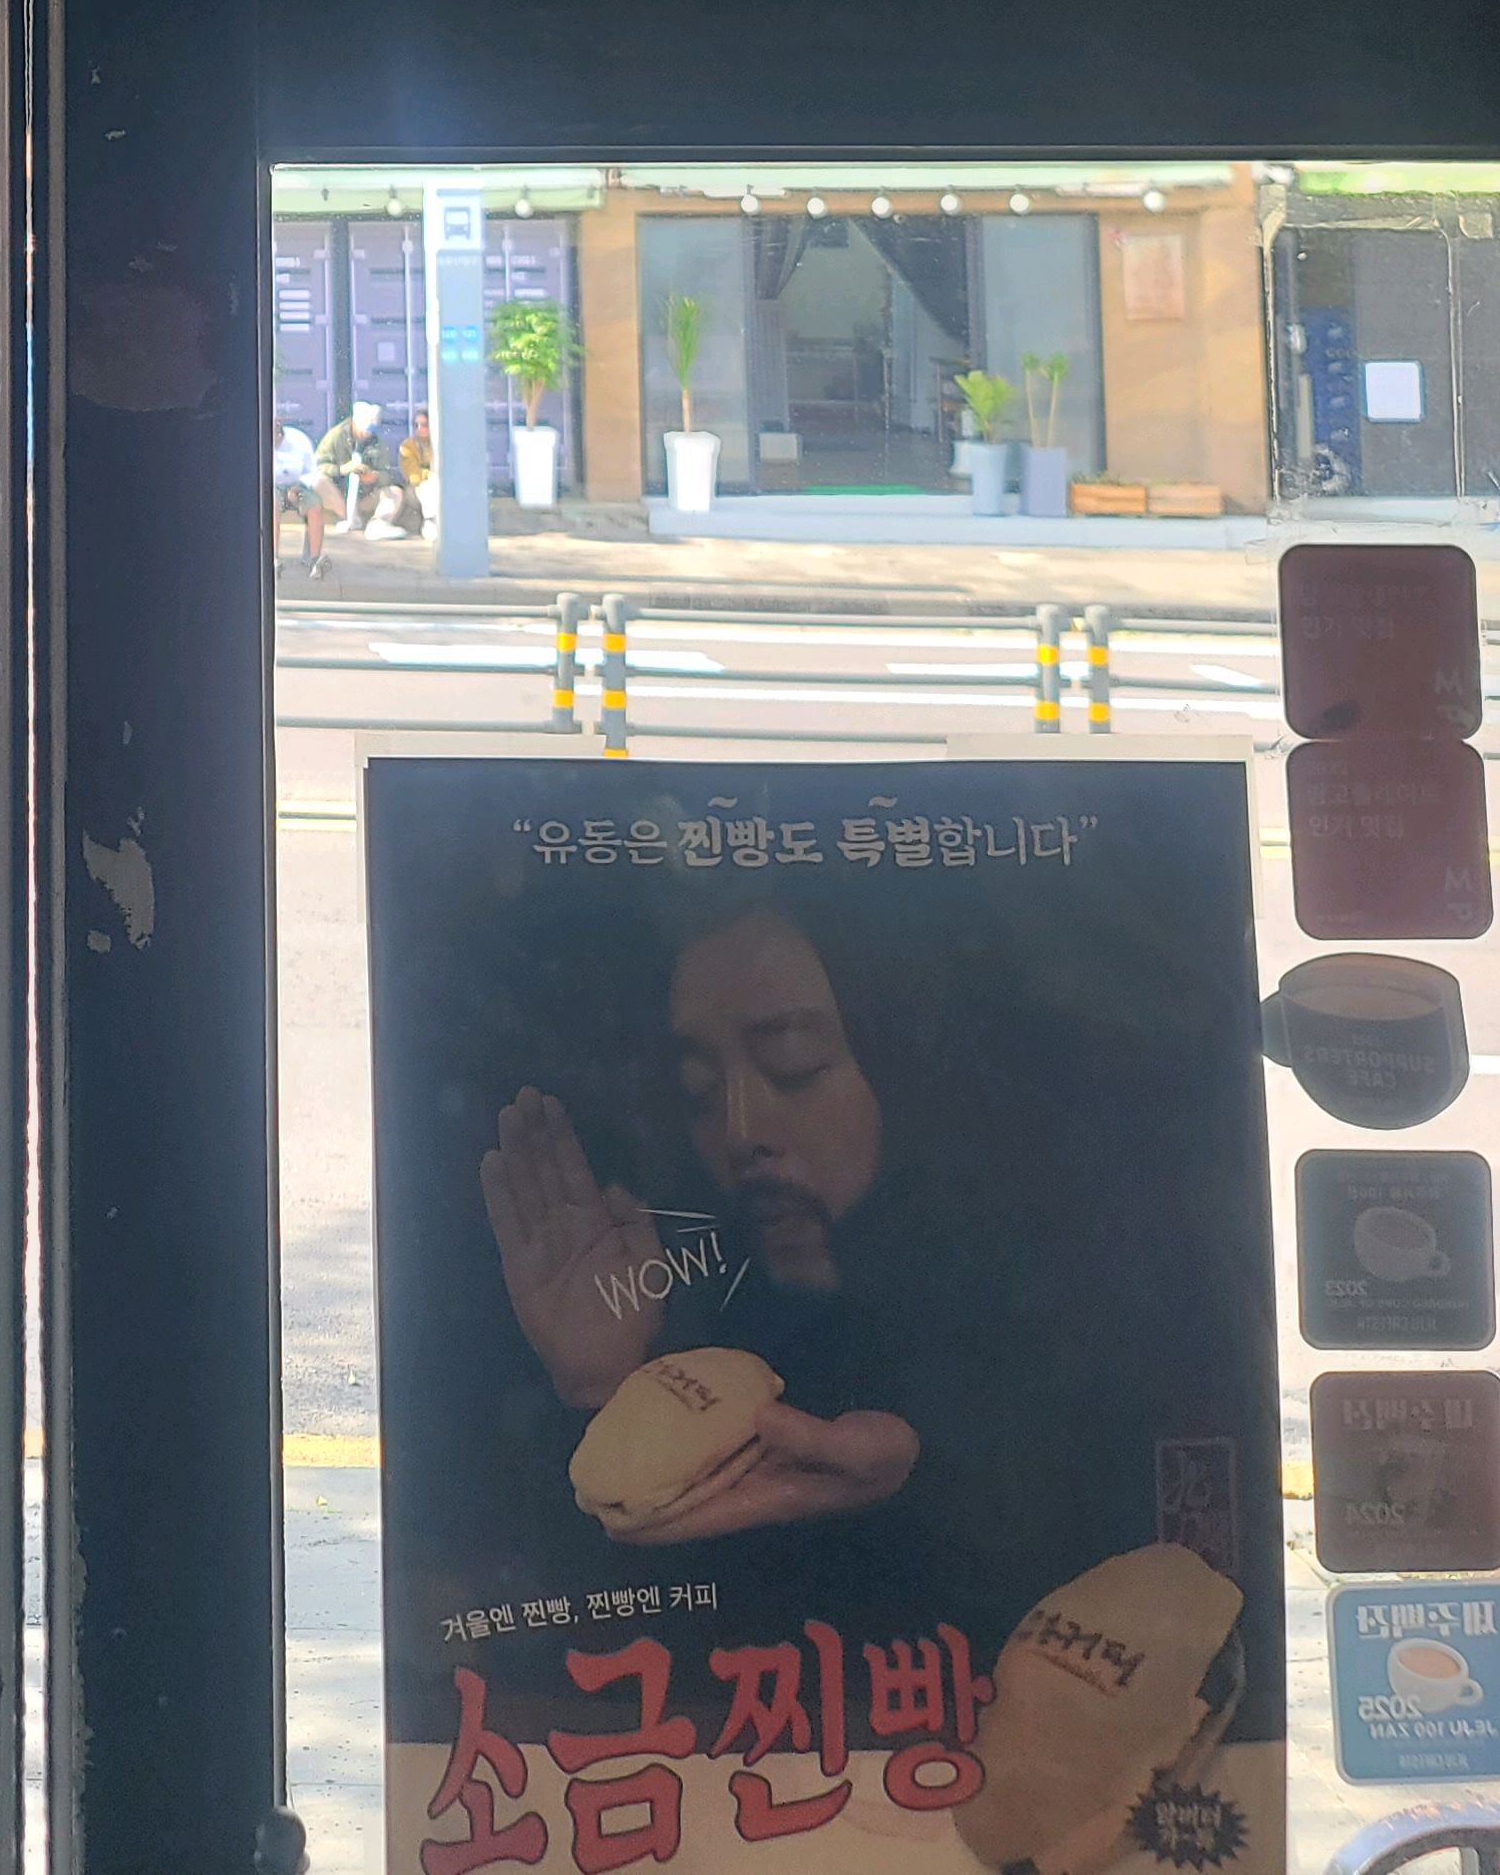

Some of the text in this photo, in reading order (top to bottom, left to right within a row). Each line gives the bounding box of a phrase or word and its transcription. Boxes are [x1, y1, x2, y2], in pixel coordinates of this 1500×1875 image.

[677, 815, 825, 867] 찐빵도
[595, 1231, 728, 1321] WOW!
[440, 1582, 718, 1642] 겨울엔 찐빵, 찐빵엔 커피
